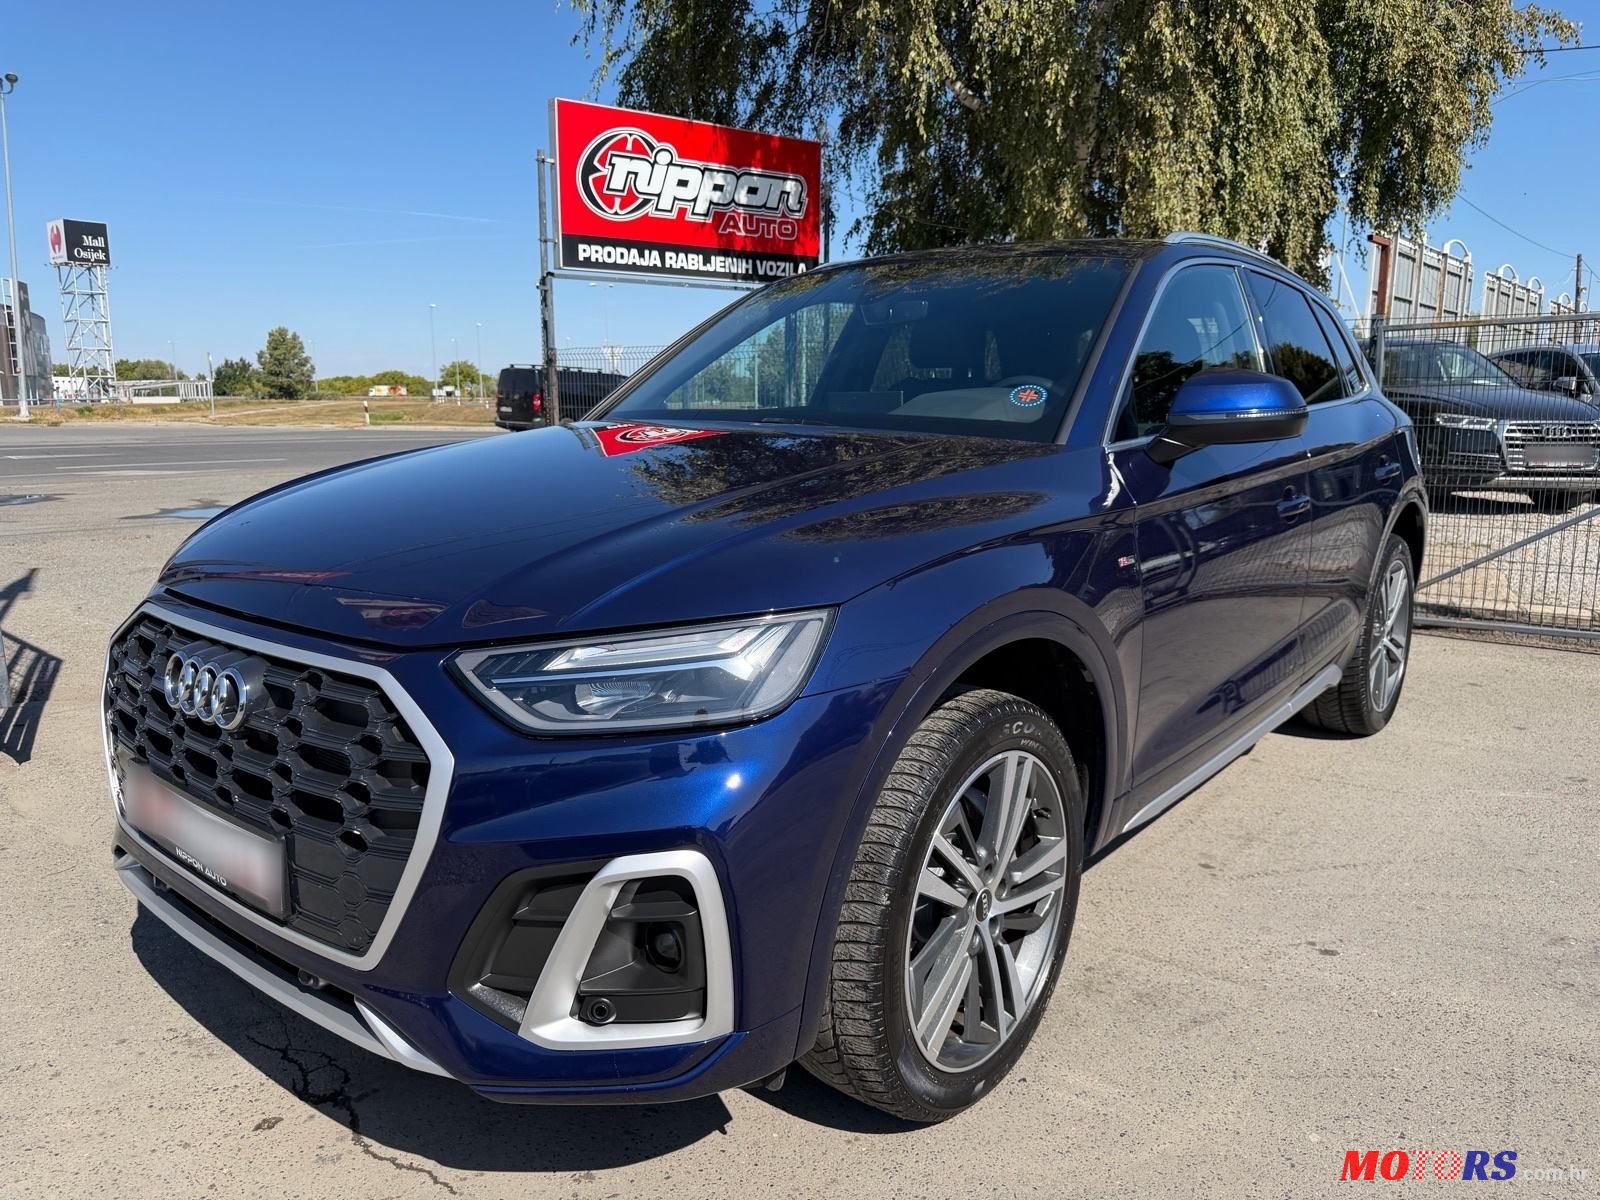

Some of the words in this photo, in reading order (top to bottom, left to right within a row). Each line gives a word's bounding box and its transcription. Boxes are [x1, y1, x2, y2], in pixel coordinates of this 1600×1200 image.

[604, 145, 806, 221] nippon
[81, 234, 105, 247] Mall
[719, 213, 798, 240] AUTO
[74, 247, 106, 262] Osijek
[577, 243, 660, 268] PRODAJA
[665, 251, 752, 275] RABLJENIH
[756, 259, 807, 277] VOZILA
[175, 846, 203, 872] NIPPON
[205, 867, 227, 886] AUTO
